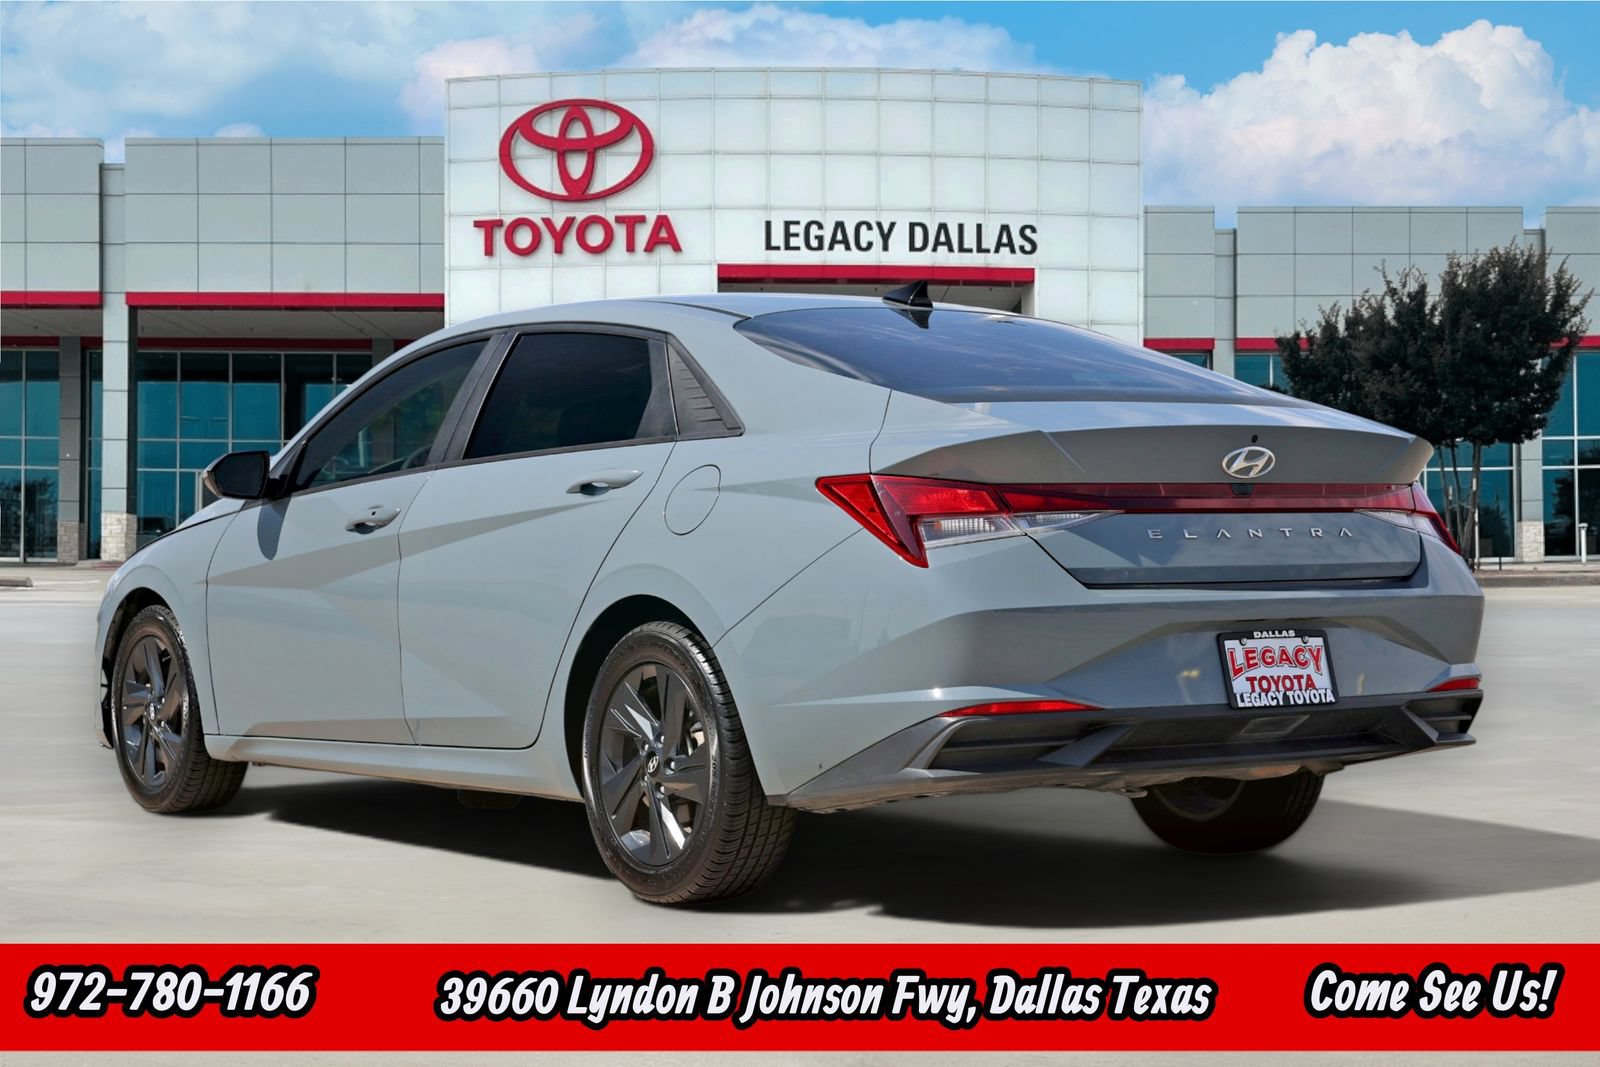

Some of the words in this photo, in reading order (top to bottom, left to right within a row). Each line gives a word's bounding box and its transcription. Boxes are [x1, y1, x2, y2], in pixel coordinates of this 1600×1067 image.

[474, 214, 682, 257] TOYOTA
[764, 220, 896, 252] LEGACY
[908, 222, 1039, 255] DALLAS
[1147, 527, 1353, 539] ELANTRA
[1253, 630, 1296, 639] DALLAS
[1227, 645, 1323, 681] LEGACY
[1245, 674, 1317, 693] TOYOTA
[1236, 690, 1285, 708] LEGACY
[1287, 688, 1336, 705] TOYOTA
